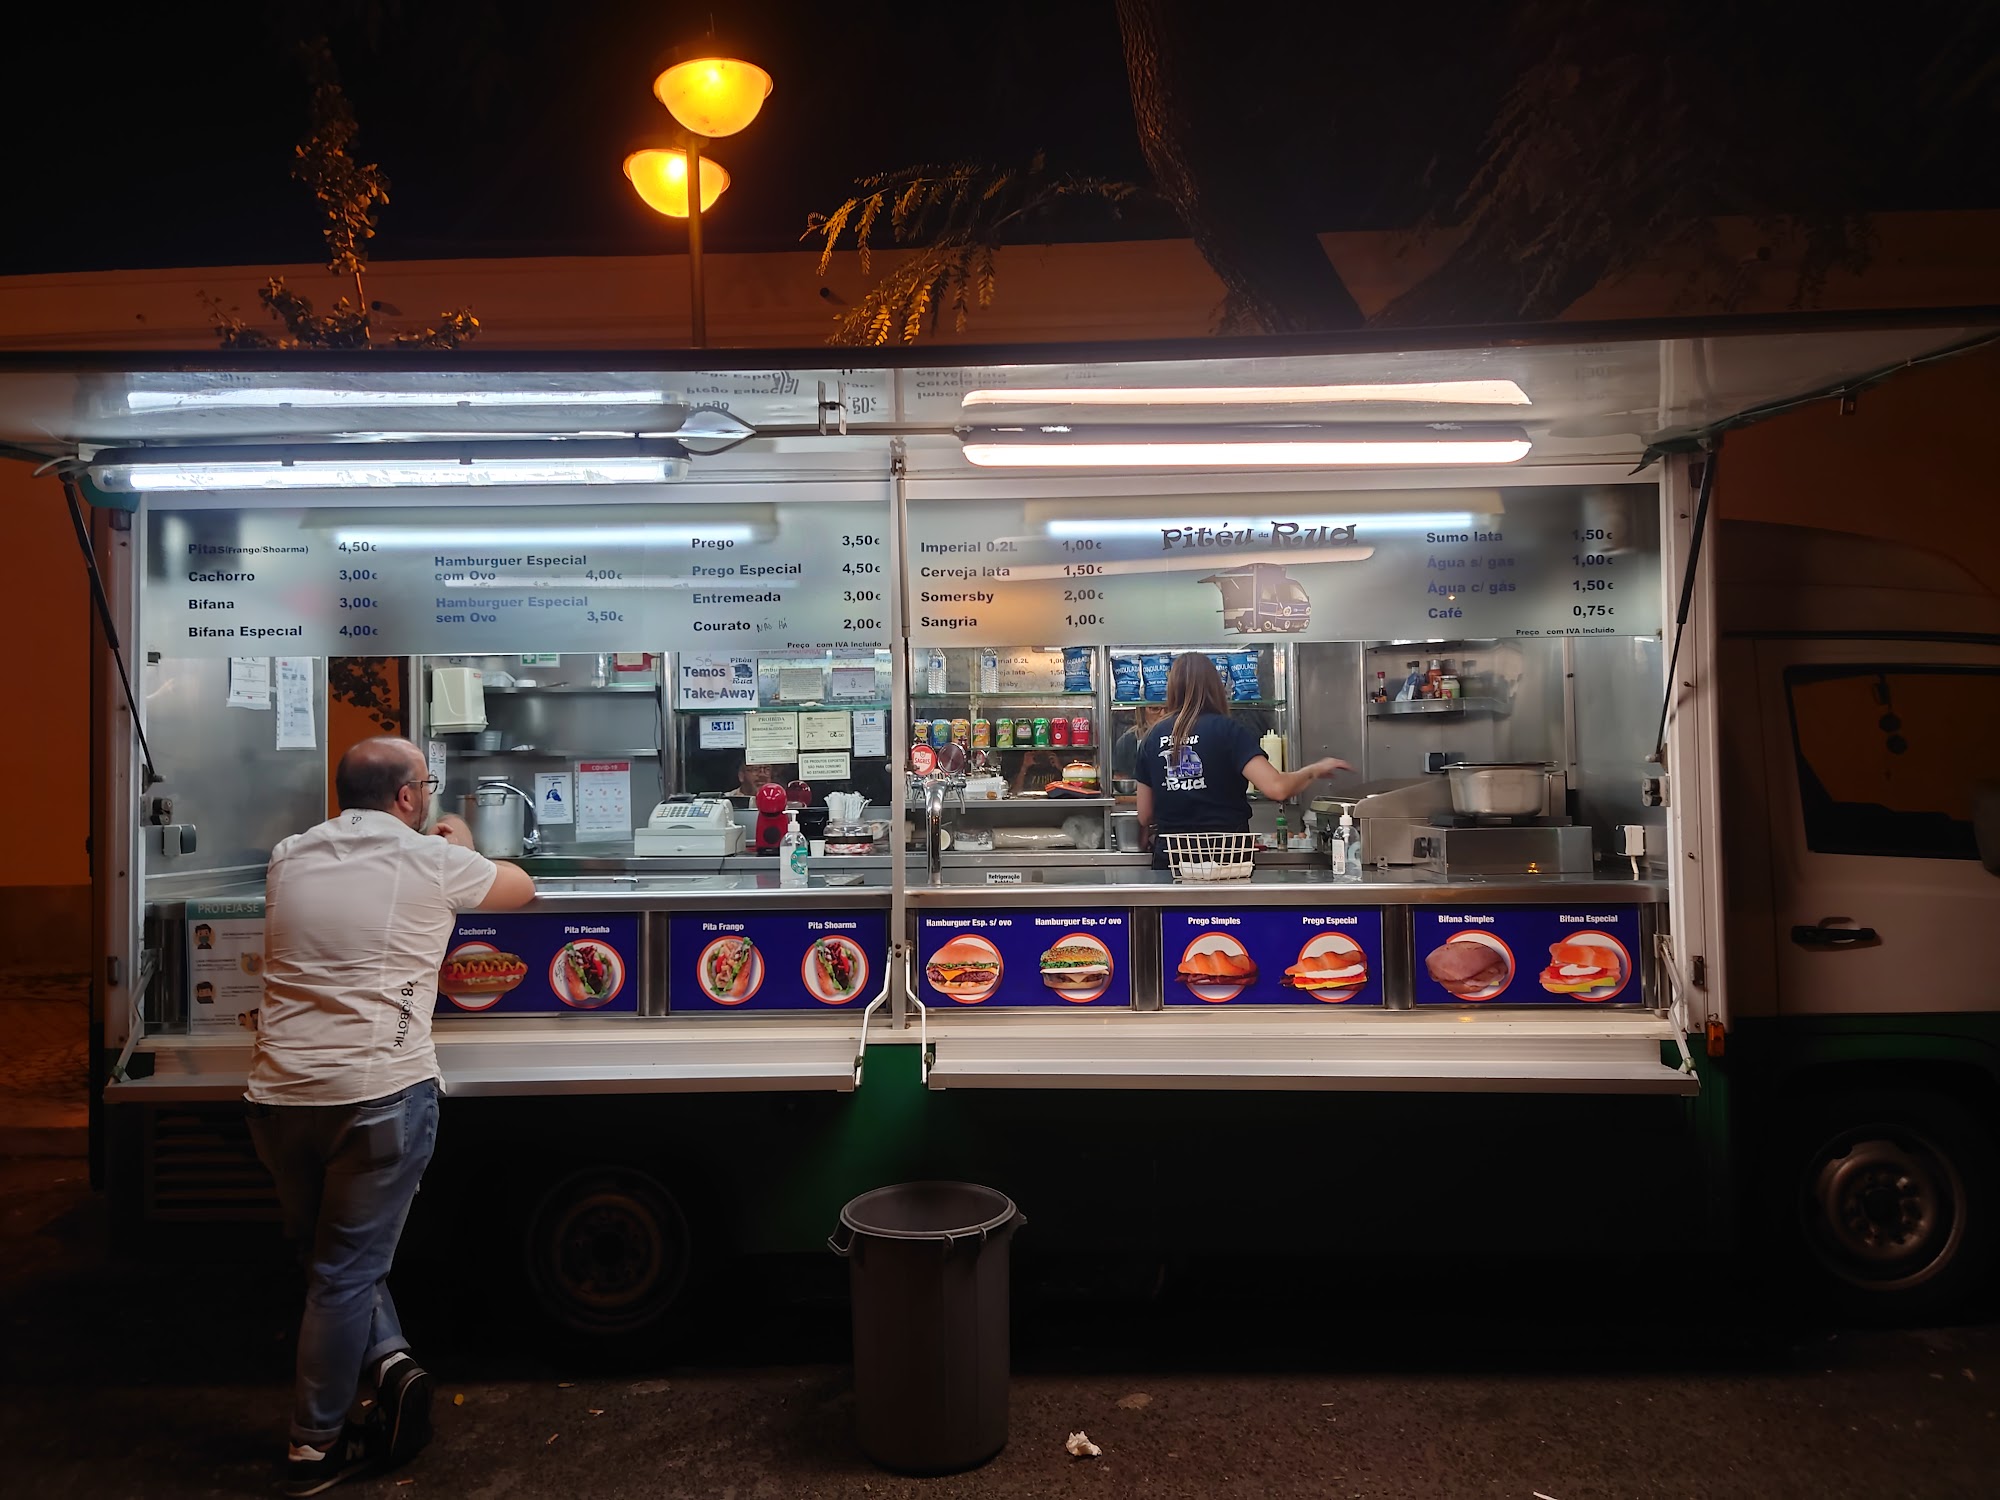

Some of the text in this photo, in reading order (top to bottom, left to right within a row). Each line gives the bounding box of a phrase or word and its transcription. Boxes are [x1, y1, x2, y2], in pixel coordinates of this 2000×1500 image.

[1161, 522, 1254, 550] Pitéu
[1271, 521, 1358, 548] Rua
[1426, 532, 1468, 543] Sumo
[1474, 531, 1503, 542] lata
[339, 541, 377, 554] 4,50€
[692, 535, 880, 550] Prego 3,50€
[920, 539, 1102, 554] Imperial 0.2L 1,00€
[434, 554, 587, 568] Hamburguer Especial
[1427, 555, 1465, 570] Água
[1471, 556, 1482, 567] s/
[1572, 554, 1613, 567] 1,00€
[188, 569, 378, 582] Cachorro 3,00€
[435, 569, 623, 582] com Ovo 4,00€
[692, 563, 881, 579] Prego Especial 4,50€
[920, 564, 1103, 579] Cerveja lata 1,50€
[1428, 580, 1614, 595] Água c/ gás 1,50€
[436, 595, 588, 610] Hamburguer Especial
[693, 590, 881, 604] Entremeada 3,00€
[920, 589, 1104, 604] Somersby 2,00€
[188, 597, 378, 610] Bifana 3,00€
[436, 611, 624, 624] sem Ovo 3,50€
[1428, 605, 1614, 618] Café 0,75€
[693, 618, 882, 632] Courato 2,00€
[920, 614, 1104, 629] Sangria 1,00€
[188, 625, 378, 639] Bifana Especial 4,00€
[1516, 629, 1539, 637] Preço
[683, 666, 726, 677] Temos
[683, 687, 755, 700] Take-Away
[1165, 777, 1207, 791] Rua
[198, 903, 260, 914] PROTEJA-SE
[808, 920, 857, 930] Pita Shoarma
[926, 918, 971, 928] Hamburguer
[972, 918, 988, 928] Esp.
[989, 917, 998, 927] s/
[1035, 917, 1080, 928] Hamburguer
[1082, 917, 1097, 928] Esp.
[1099, 916, 1107, 926] c/
[1188, 916, 1241, 927] Prego Simples
[1302, 916, 1357, 926] Prego Especial
[1438, 914, 1494, 925] Bifana Simples
[1559, 914, 1618, 925] Bifana Especial
[458, 927, 497, 936] Cachorrão
[564, 925, 610, 934] Pita Picanha
[702, 923, 745, 932] Pita Frango
